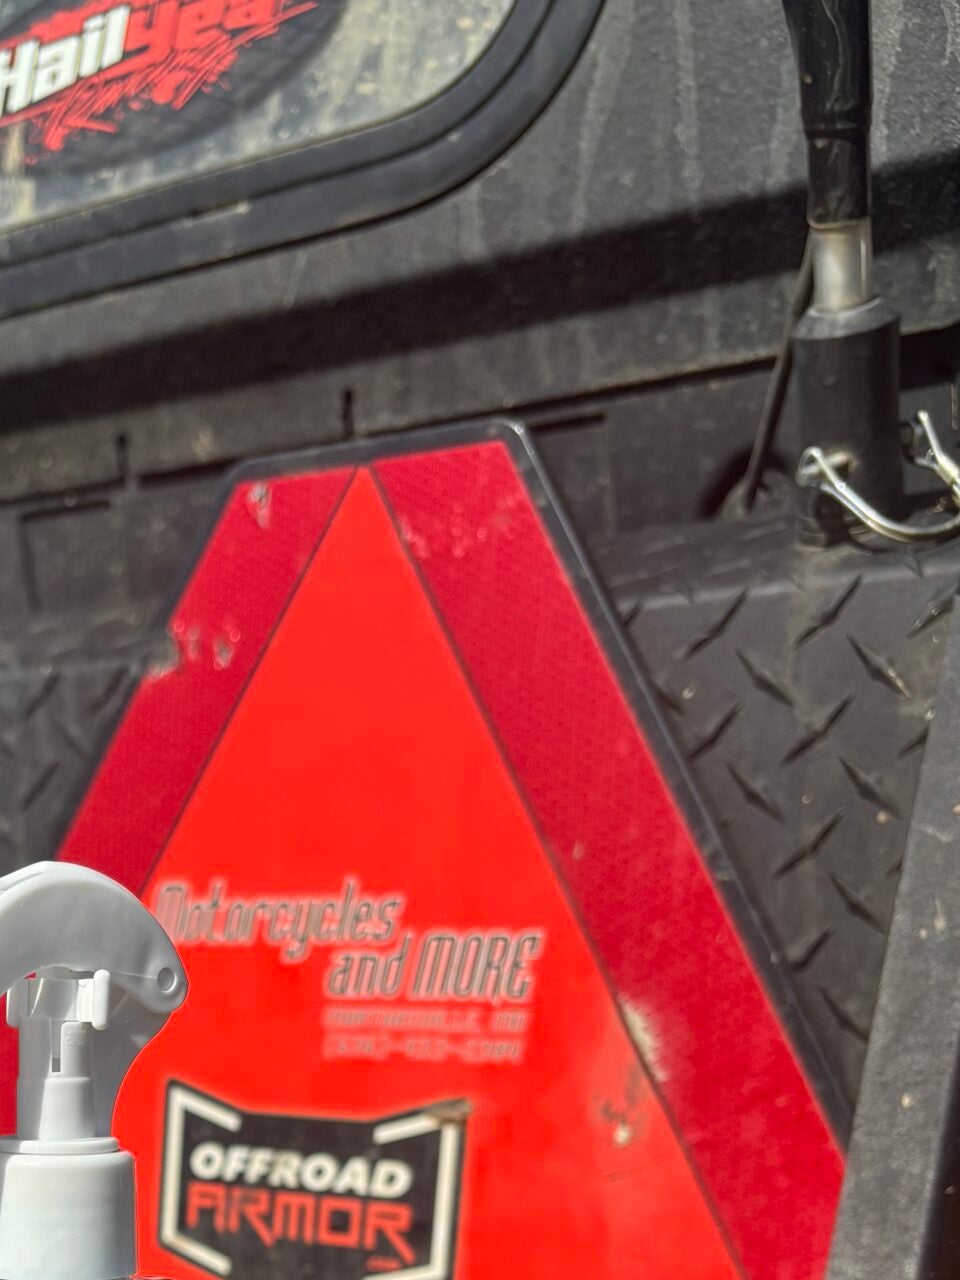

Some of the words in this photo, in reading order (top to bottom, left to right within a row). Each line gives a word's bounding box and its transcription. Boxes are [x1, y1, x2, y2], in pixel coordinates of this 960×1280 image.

[157, 876, 402, 961] Motorcycles
[326, 934, 413, 1000] and
[410, 928, 543, 1003] MORE
[189, 1142, 413, 1198] OFFROAD
[185, 1181, 416, 1265] ARMOR
